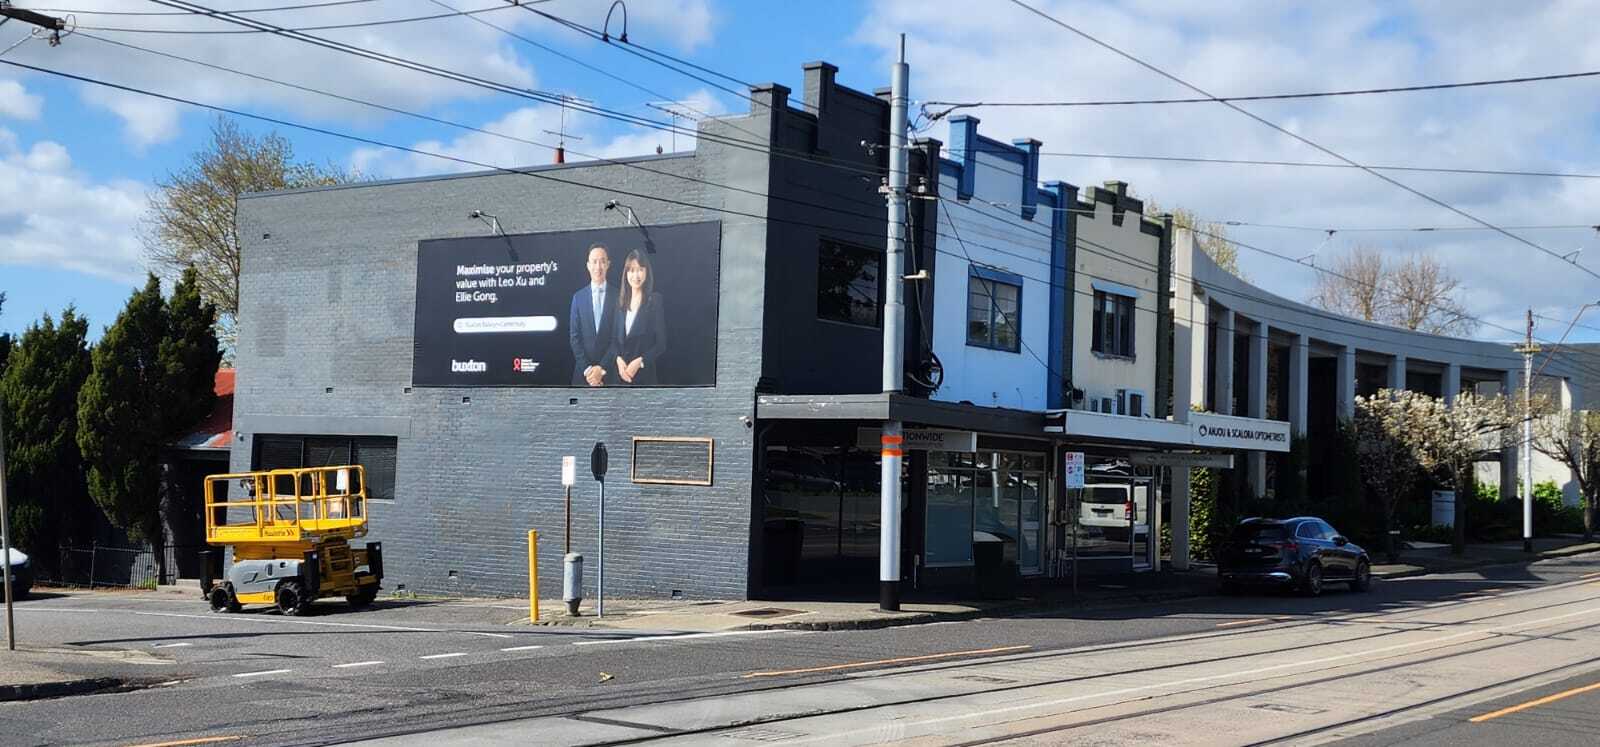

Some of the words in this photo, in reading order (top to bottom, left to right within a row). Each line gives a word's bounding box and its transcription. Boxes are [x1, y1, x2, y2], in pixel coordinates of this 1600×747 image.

[456, 264, 495, 276] Maximise
[495, 265, 515, 276] your
[516, 261, 558, 275] property's
[456, 278, 478, 289] value
[479, 277, 497, 288] with
[498, 277, 514, 287] Leo
[515, 276, 527, 287] Xu
[528, 275, 545, 286] and
[455, 291, 472, 302] Ellie
[473, 291, 498, 304] Gong.
[451, 359, 487, 372] buxton
